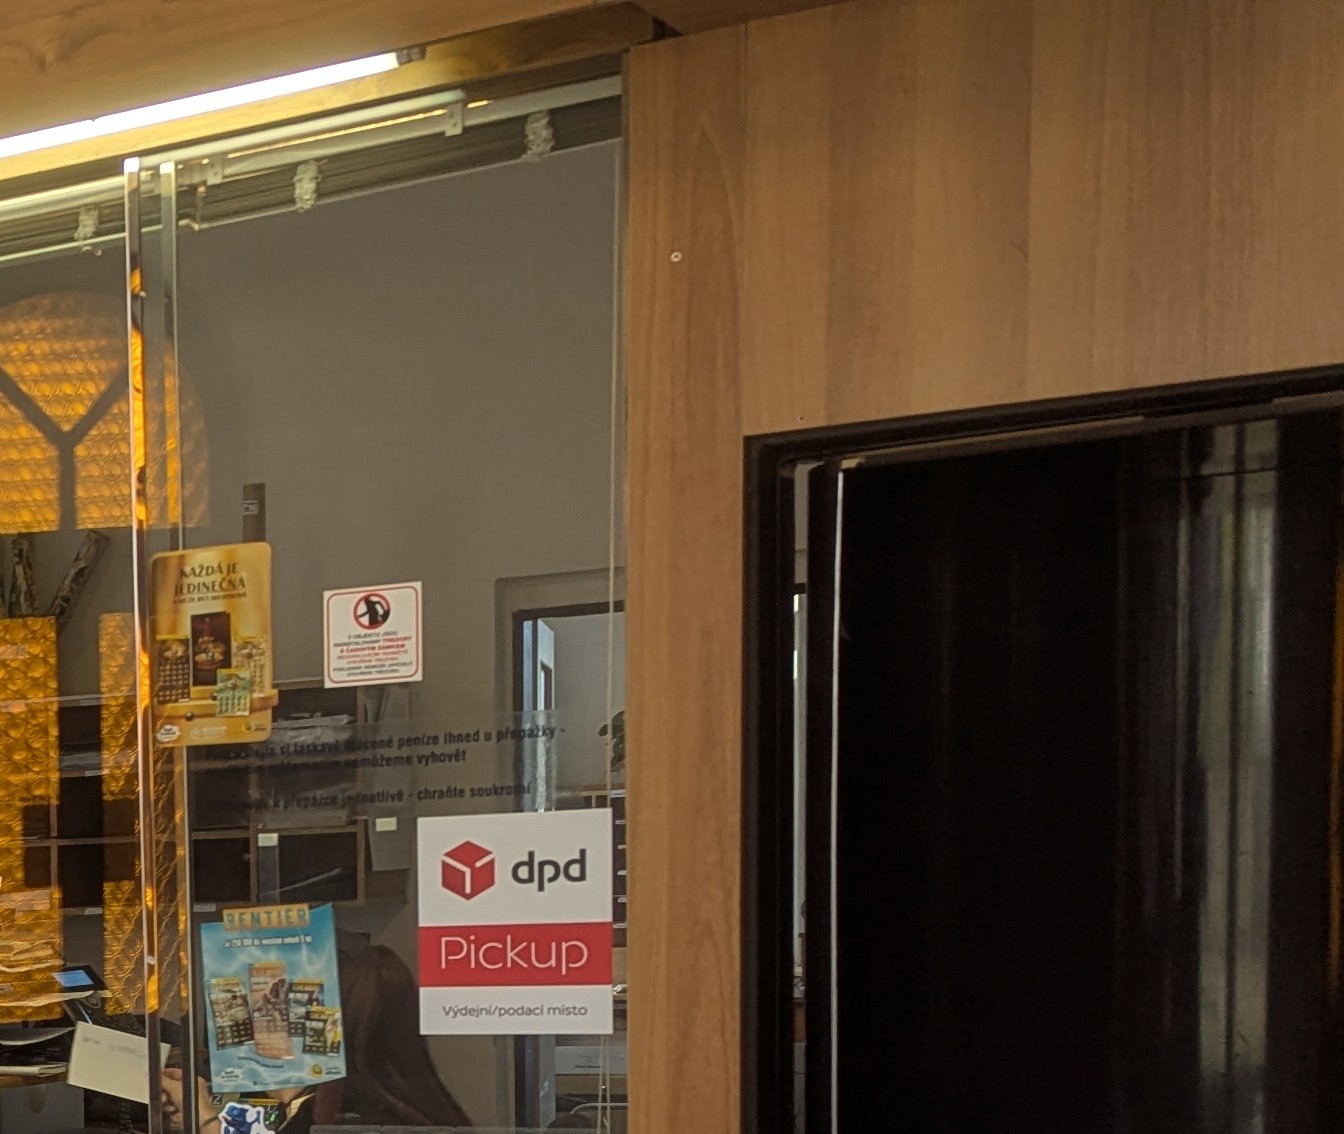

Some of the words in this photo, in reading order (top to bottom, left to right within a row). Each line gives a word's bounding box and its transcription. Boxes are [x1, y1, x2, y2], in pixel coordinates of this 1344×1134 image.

[226, 561, 239, 577] JE
[397, 732, 439, 750] peníze
[444, 729, 479, 744] ihned
[484, 732, 492, 742] u
[417, 749, 467, 767] vyhovět
[417, 785, 465, 800] chraňte
[470, 780, 531, 797] soukromí
[512, 848, 587, 892] dpd
[226, 907, 308, 928] RENTIER
[441, 934, 589, 975] Pickup
[442, 1004, 544, 1019] Výdejní/podací
[547, 1003, 588, 1017] místo
